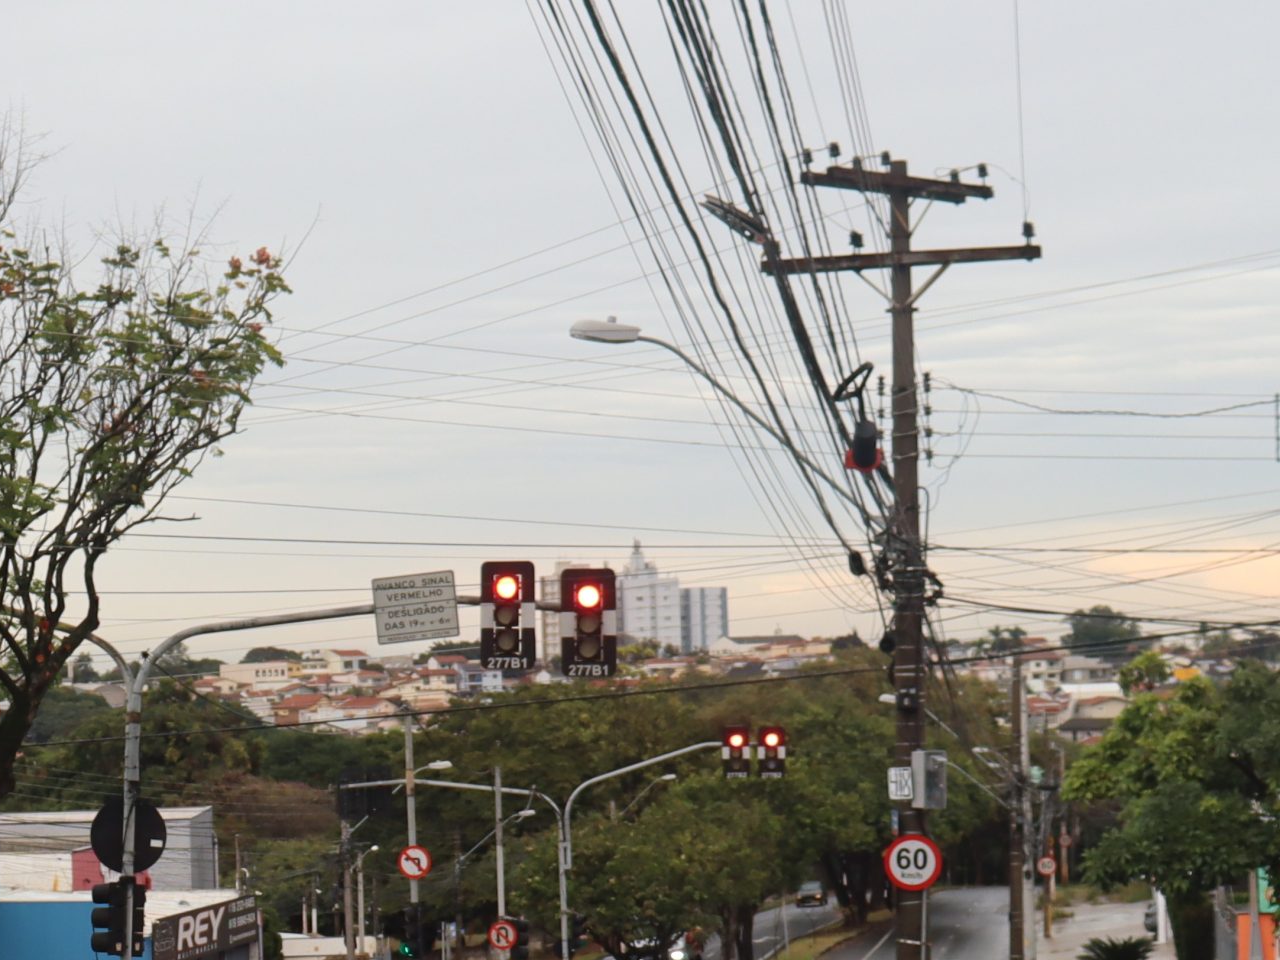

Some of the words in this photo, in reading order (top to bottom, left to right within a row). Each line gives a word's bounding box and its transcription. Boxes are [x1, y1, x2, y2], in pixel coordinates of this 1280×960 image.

[386, 588, 443, 602] VERMELHO
[387, 605, 445, 619] DESLIGADO
[384, 621, 405, 631] DAS
[487, 657, 528, 668] 277B1
[568, 664, 609, 676] 277B1
[897, 848, 928, 870] 60
[177, 906, 226, 951] REY
